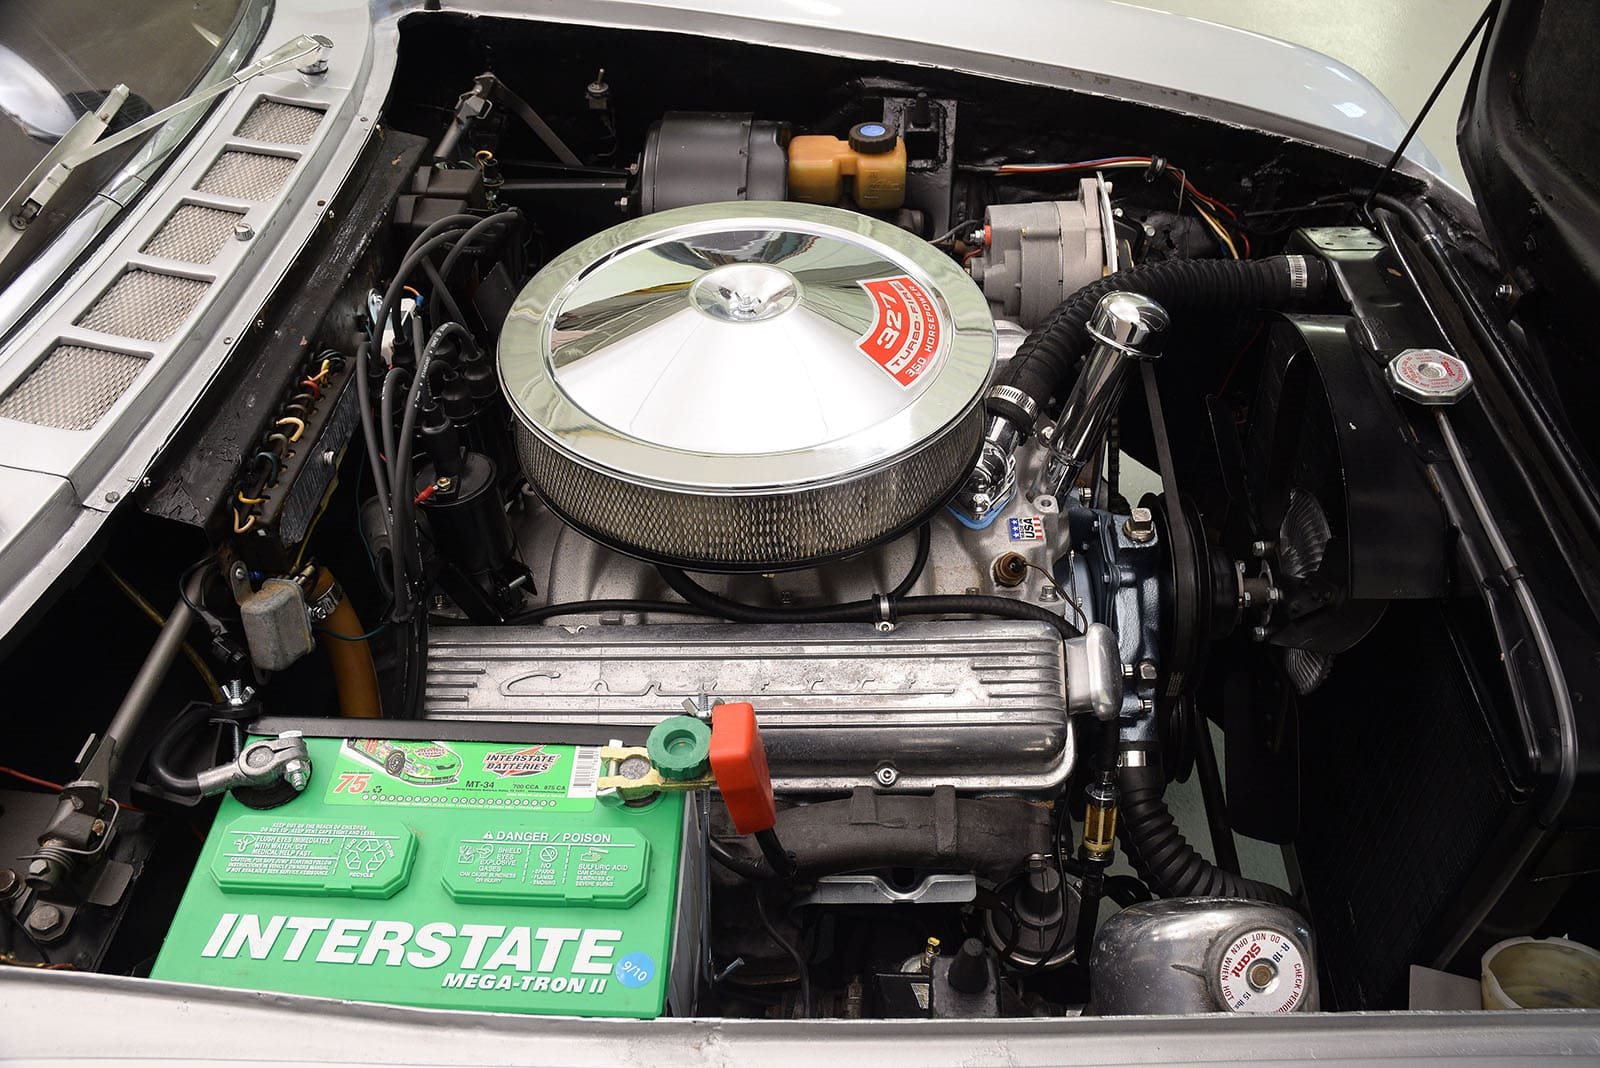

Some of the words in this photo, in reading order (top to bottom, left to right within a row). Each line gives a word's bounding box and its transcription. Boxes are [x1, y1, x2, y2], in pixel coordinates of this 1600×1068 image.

[876, 291, 902, 350] 327
[891, 281, 921, 368] TURBO-FIRE
[908, 285, 937, 353] HORSEPOWER
[905, 356, 926, 377] 350
[1023, 518, 1035, 539] USA
[485, 754, 557, 763] INTERSTATE
[486, 762, 549, 771] BATTERIES
[333, 773, 372, 794] 75
[465, 780, 495, 788] MT-34
[293, 837, 335, 845] IMMEDIATELY
[496, 831, 549, 842] DANGER
[562, 833, 611, 843] POISON
[577, 863, 611, 871] SULFURIC
[611, 864, 630, 872] ACID
[200, 913, 624, 974] INTERSTATE
[1231, 938, 1249, 955] OPEN
[1252, 932, 1267, 942] NOT
[1270, 934, 1281, 944] DO
[1231, 943, 1262, 978] Stant
[1272, 942, 1290, 963] R-18
[621, 960, 648, 982] 9/10
[1221, 957, 1233, 981] WHEN
[1293, 963, 1302, 990] CHECK
[441, 972, 586, 993] MEGA-TRON
[589, 979, 608, 994] II
[1223, 985, 1235, 1001] HOT
[1243, 991, 1252, 1001] 15
[1278, 991, 1299, 1013] PERIOD
